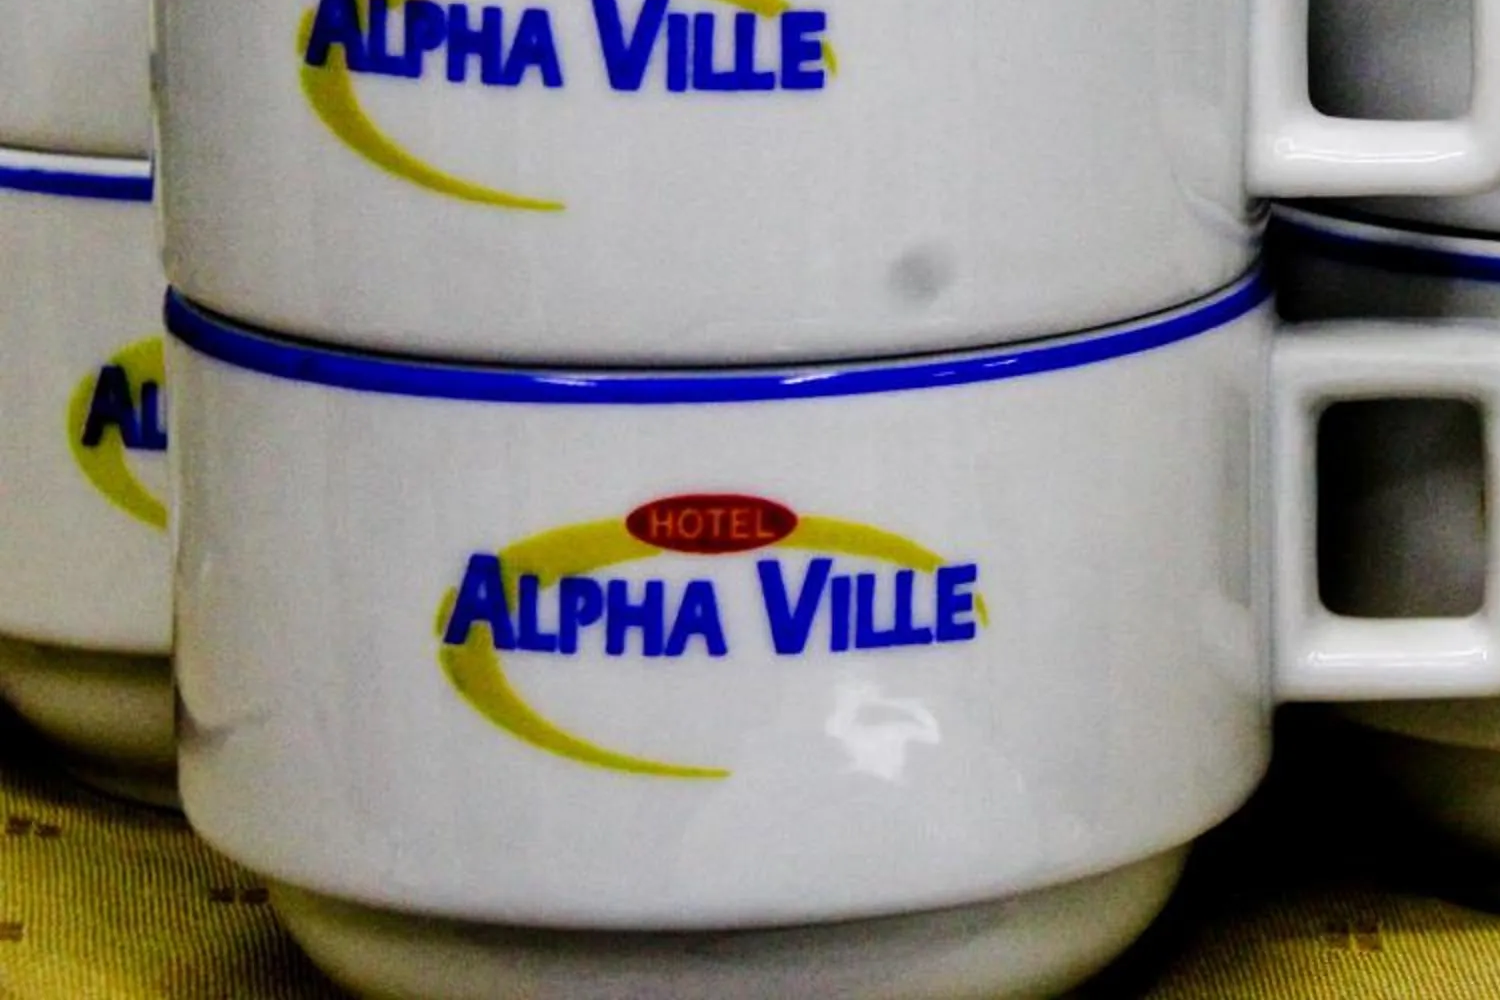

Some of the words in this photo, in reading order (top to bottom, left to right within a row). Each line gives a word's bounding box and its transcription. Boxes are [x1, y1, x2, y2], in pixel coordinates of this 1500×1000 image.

[649, 506, 776, 540] HOTEL
[443, 552, 729, 658] ALPHA
[756, 557, 979, 656] VILLE
